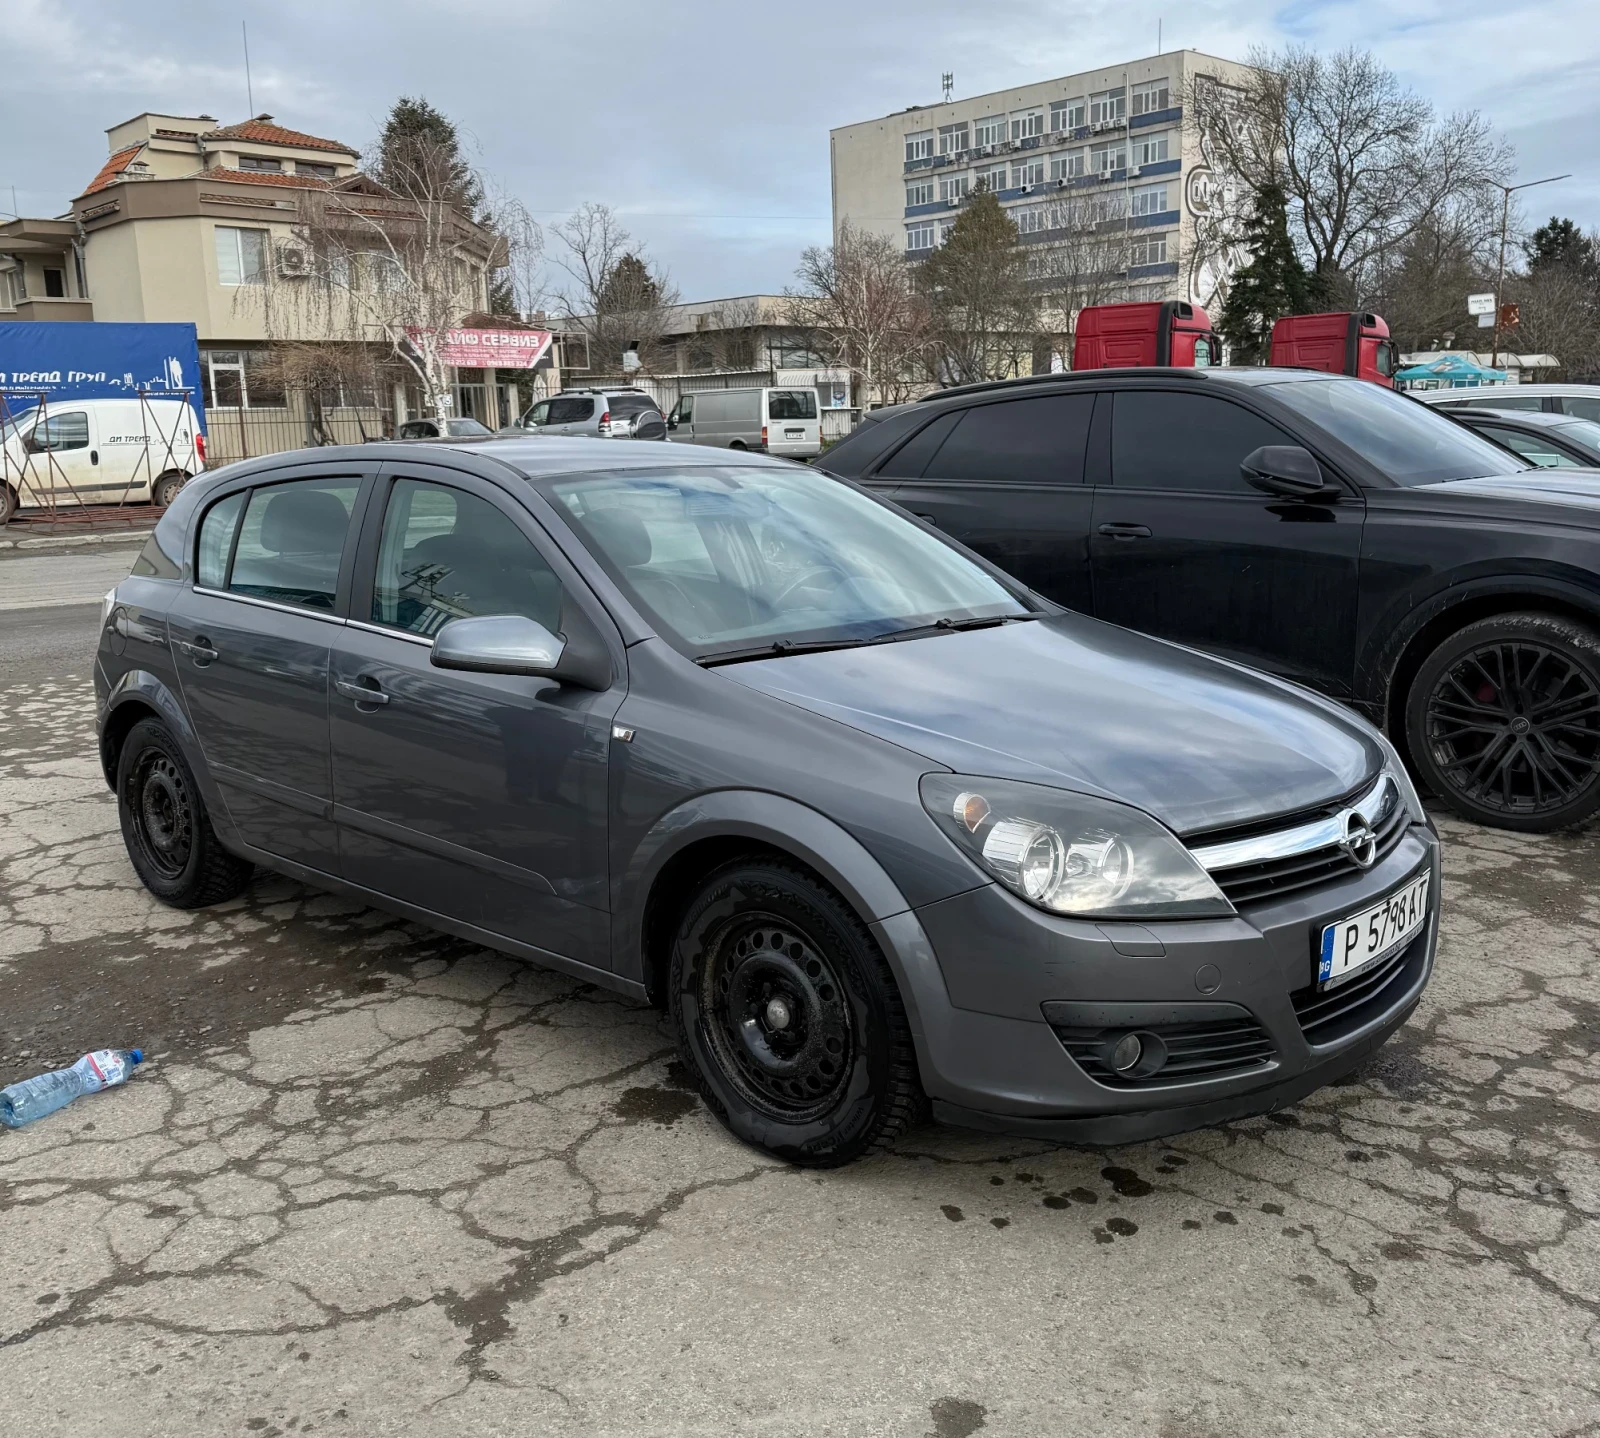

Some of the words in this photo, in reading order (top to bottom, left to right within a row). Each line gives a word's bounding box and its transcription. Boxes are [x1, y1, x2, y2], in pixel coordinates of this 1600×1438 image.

[481, 333, 540, 348] СЕРВИЗ
[68, 370, 106, 384] ГРУП
[1344, 923, 1359, 967] P
[1367, 894, 1407, 953] 5798
[1408, 879, 1428, 926] AT
